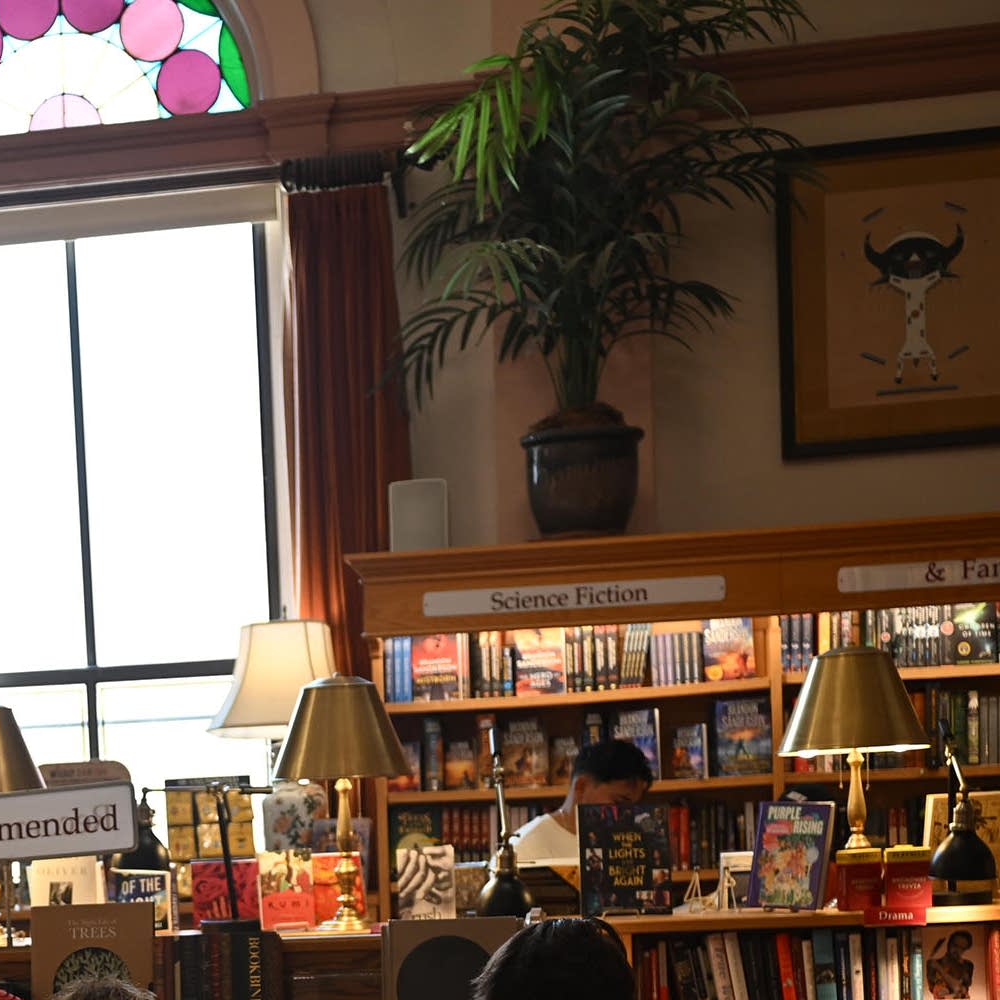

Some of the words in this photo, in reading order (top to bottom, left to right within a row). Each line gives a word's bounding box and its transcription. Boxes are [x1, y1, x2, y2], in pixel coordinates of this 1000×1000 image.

[925, 561, 946, 582] &
[490, 591, 569, 611] Science
[575, 585, 648, 605] Fiction
[767, 805, 802, 820] PURPLE
[793, 820, 824, 835] RISING
[608, 848, 646, 859] LIGHTS
[121, 878, 137, 893] OF
[139, 877, 162, 891] THE
[614, 876, 643, 886] AGAIN
[879, 910, 914, 921] Drama
[68, 926, 118, 939] TREES
